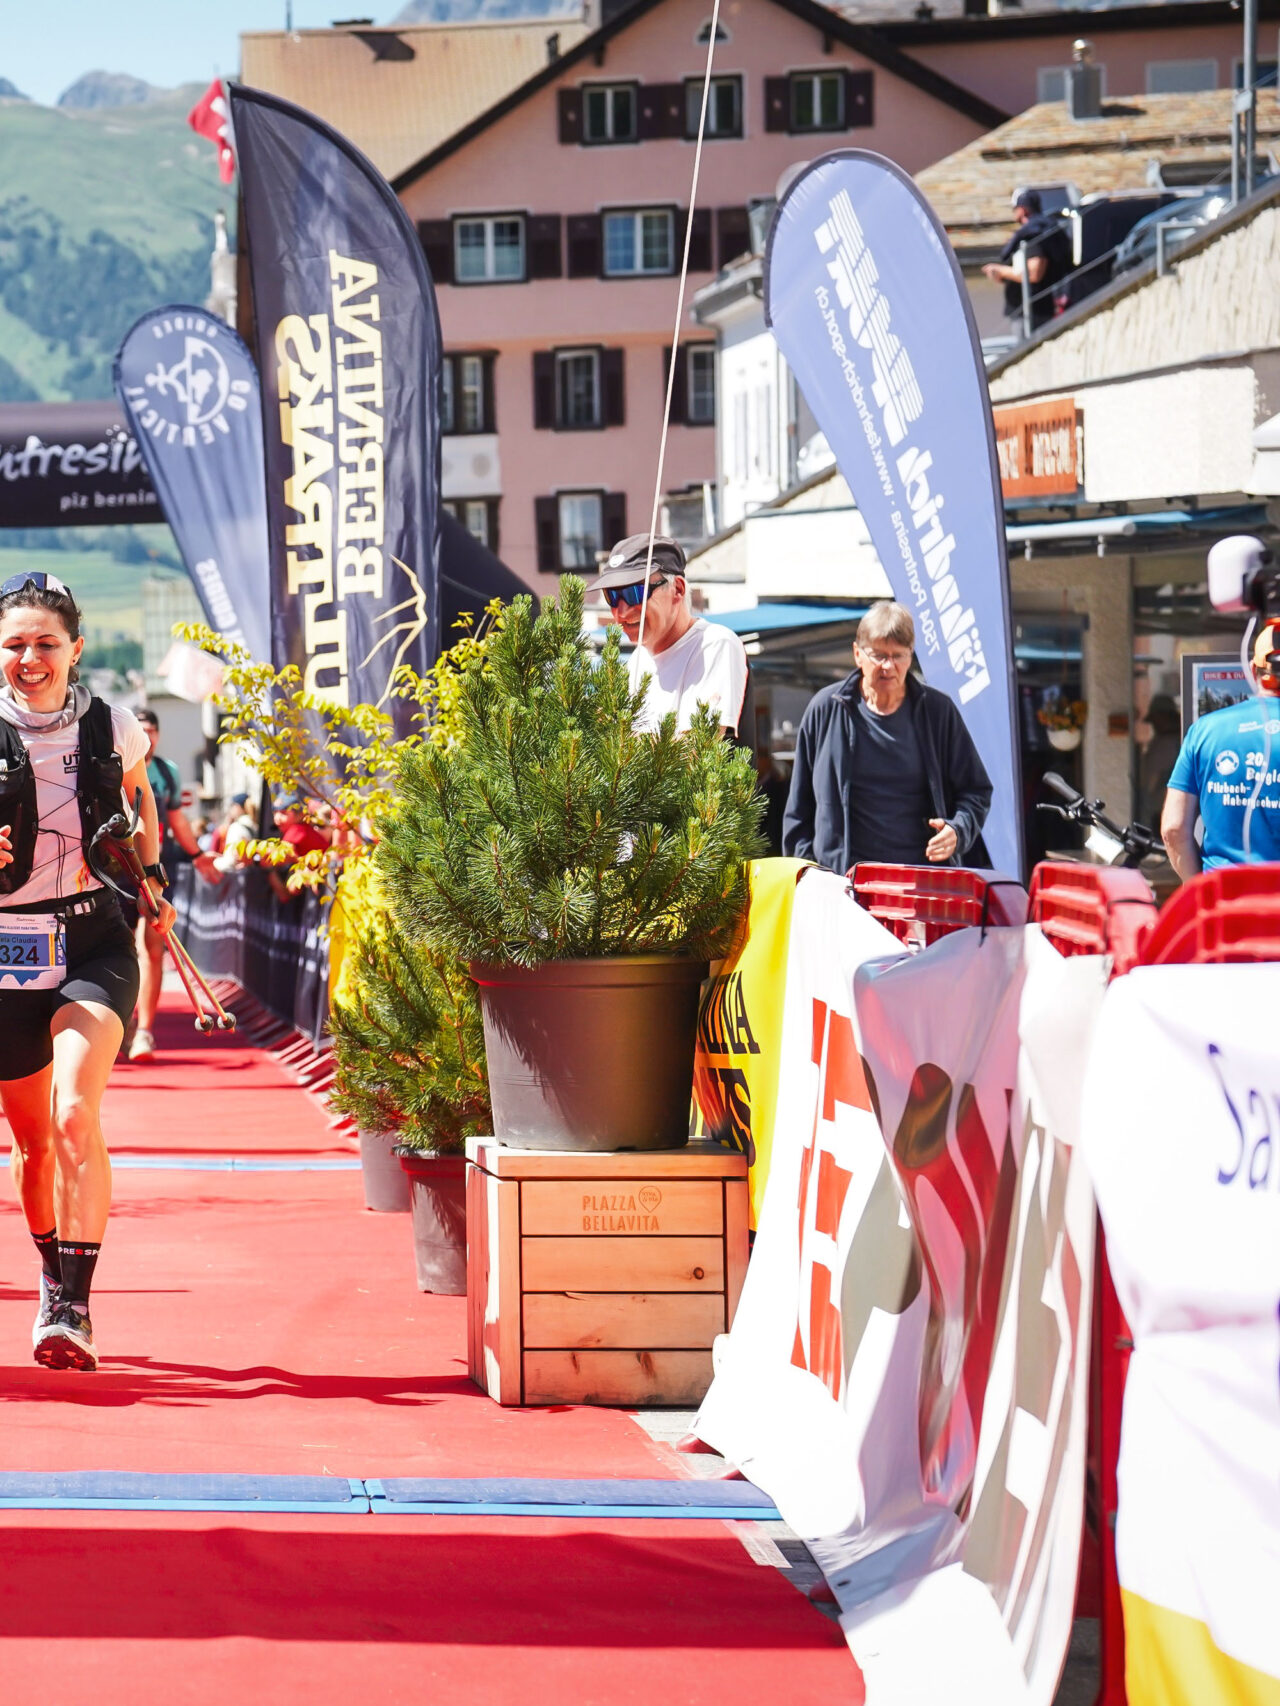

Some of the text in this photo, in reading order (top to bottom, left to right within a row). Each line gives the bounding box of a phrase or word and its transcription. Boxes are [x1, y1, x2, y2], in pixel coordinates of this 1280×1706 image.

[60, 489, 157, 512] piz bernin
[11, 935, 38, 944] Claudia
[582, 1215, 660, 1232] BELLAVITA
